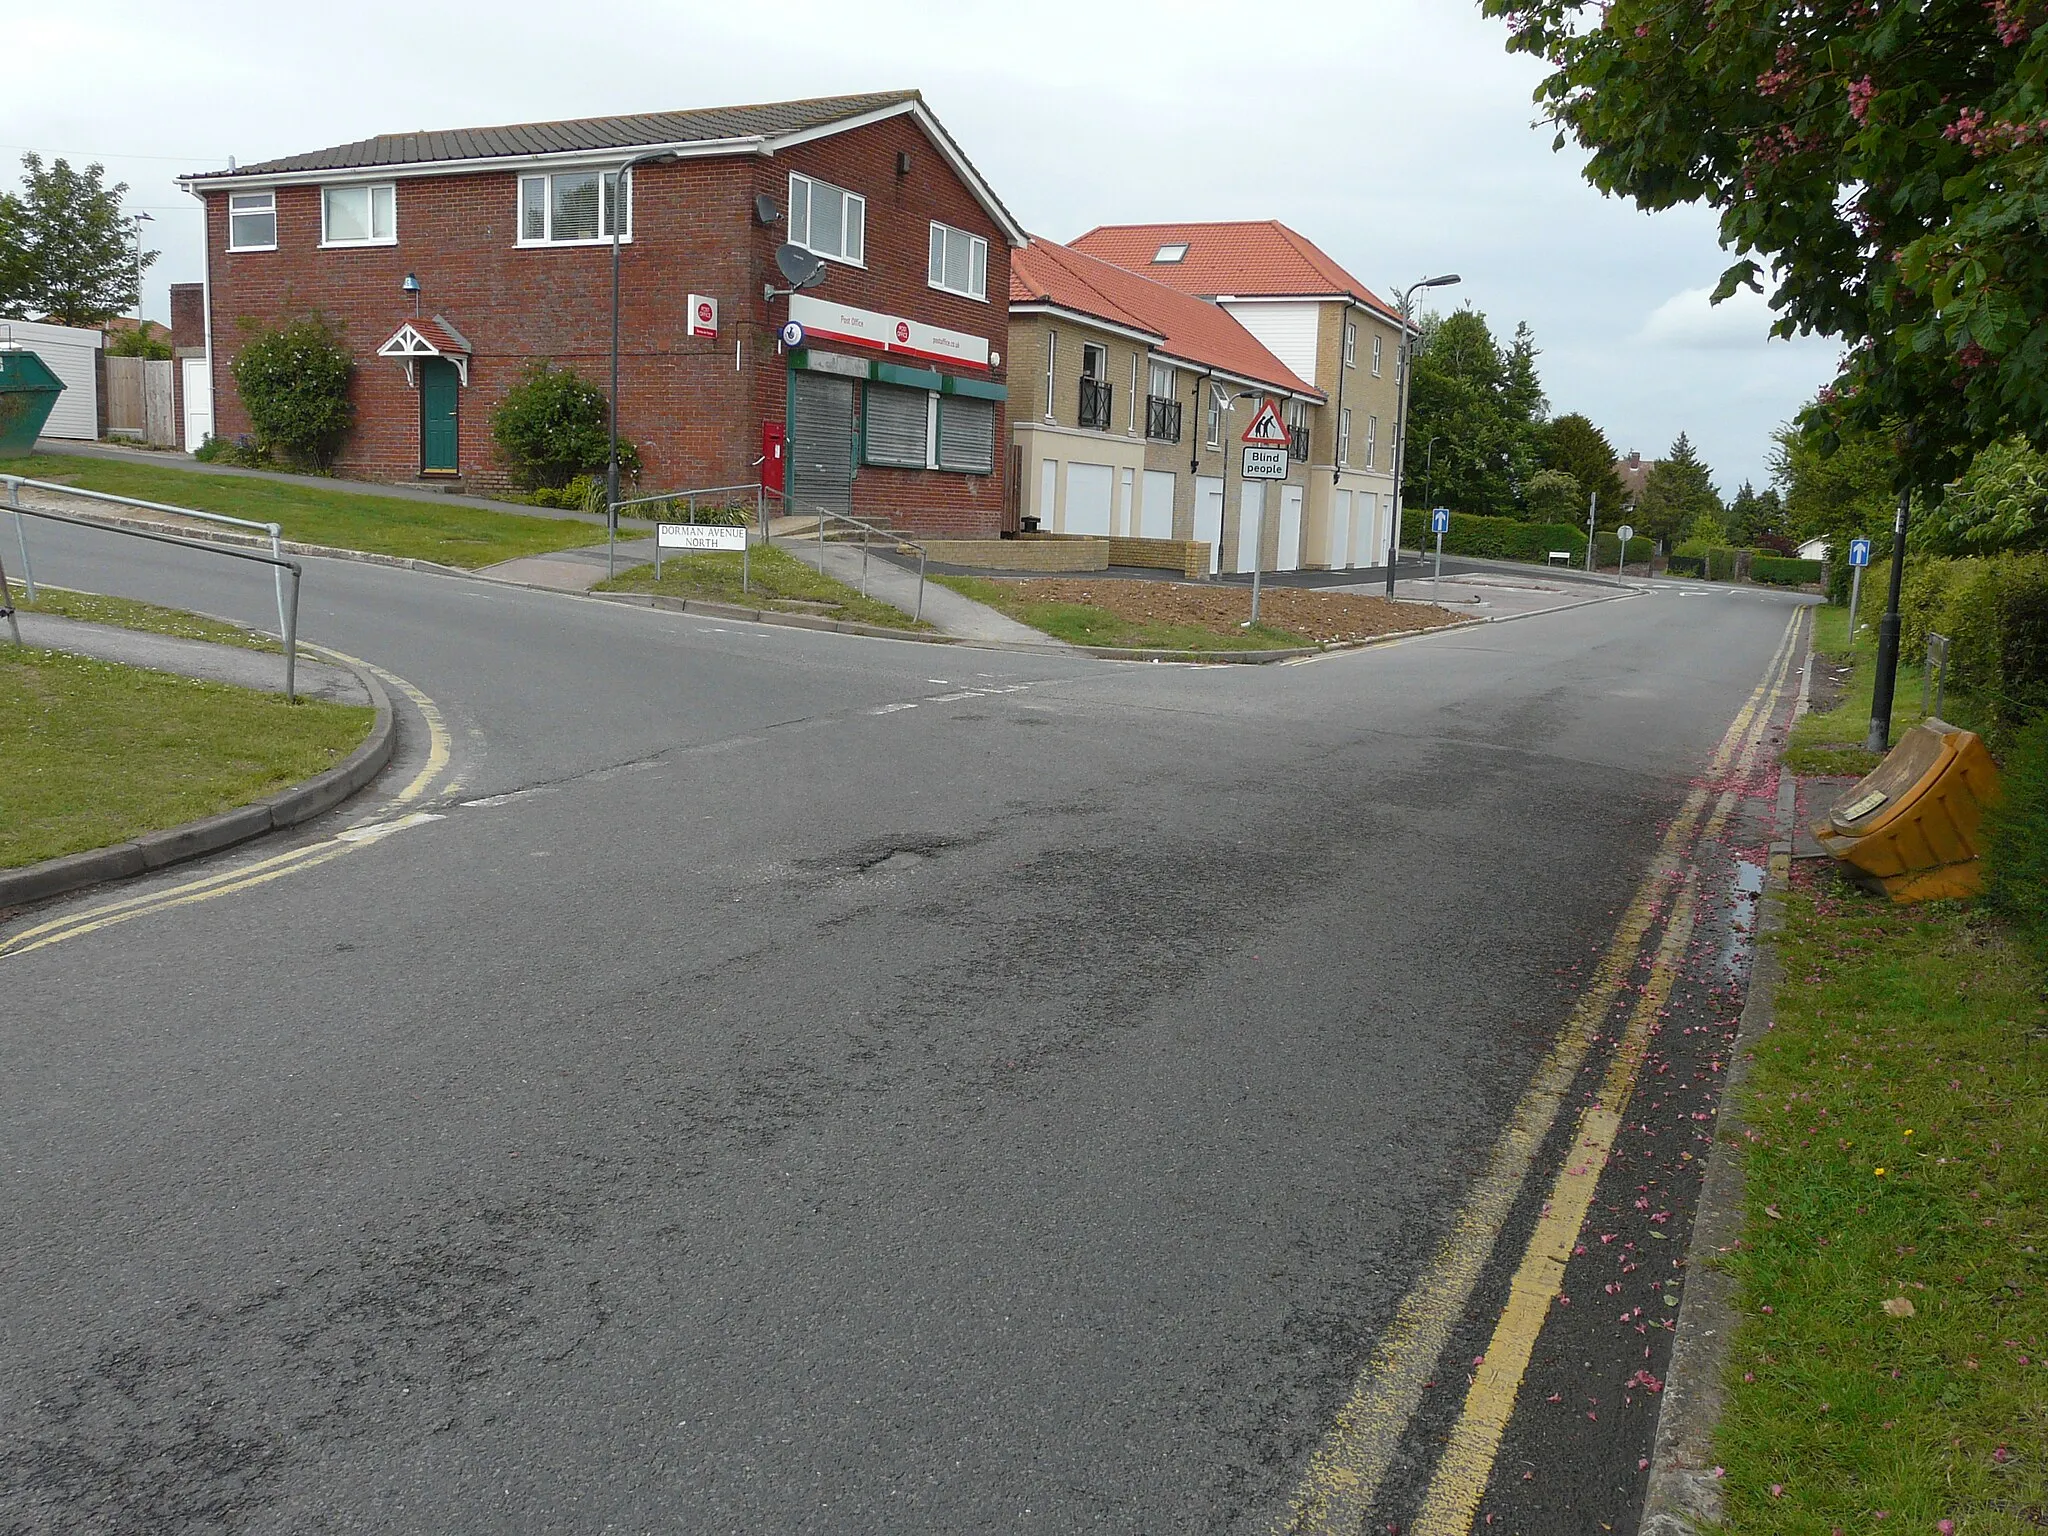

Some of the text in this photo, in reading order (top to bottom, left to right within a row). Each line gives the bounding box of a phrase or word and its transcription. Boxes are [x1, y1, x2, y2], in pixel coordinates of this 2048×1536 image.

[840, 315, 864, 327] Post Office
[1252, 452, 1280, 462] Blind
[1247, 464, 1282, 474] people
[661, 525, 744, 538] DORMAN AVENUE
[685, 538, 718, 547] NORTH
